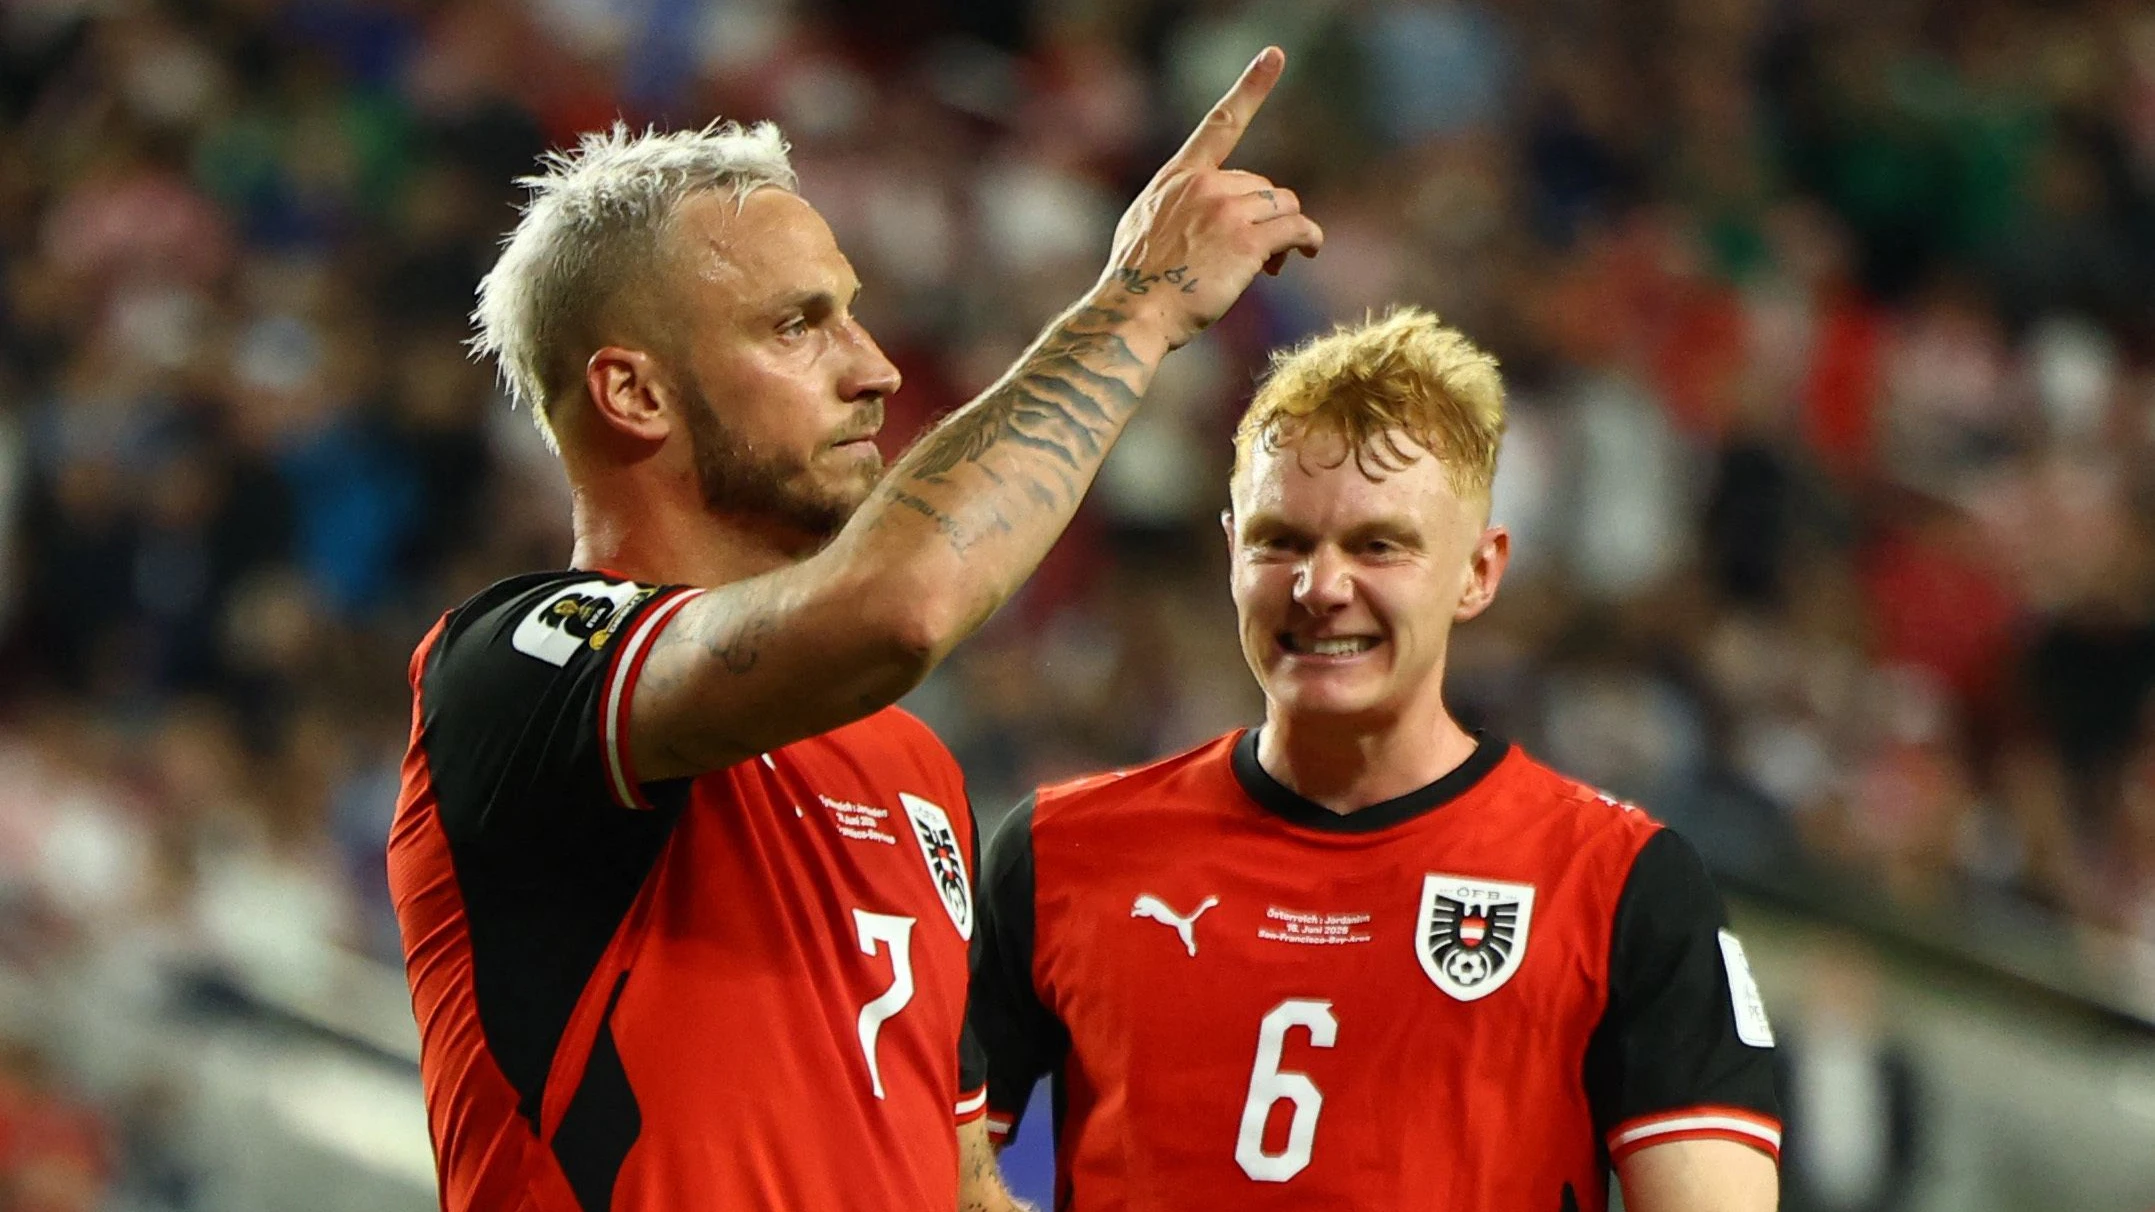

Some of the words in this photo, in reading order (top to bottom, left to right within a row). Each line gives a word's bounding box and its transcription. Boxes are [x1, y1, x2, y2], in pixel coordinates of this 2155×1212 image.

[1456, 886, 1501, 900] ÖFB
[1266, 906, 1318, 924] Österreich
[1301, 925, 1322, 934] Juni
[852, 907, 917, 1101] 7
[1234, 999, 1338, 1182] 6
